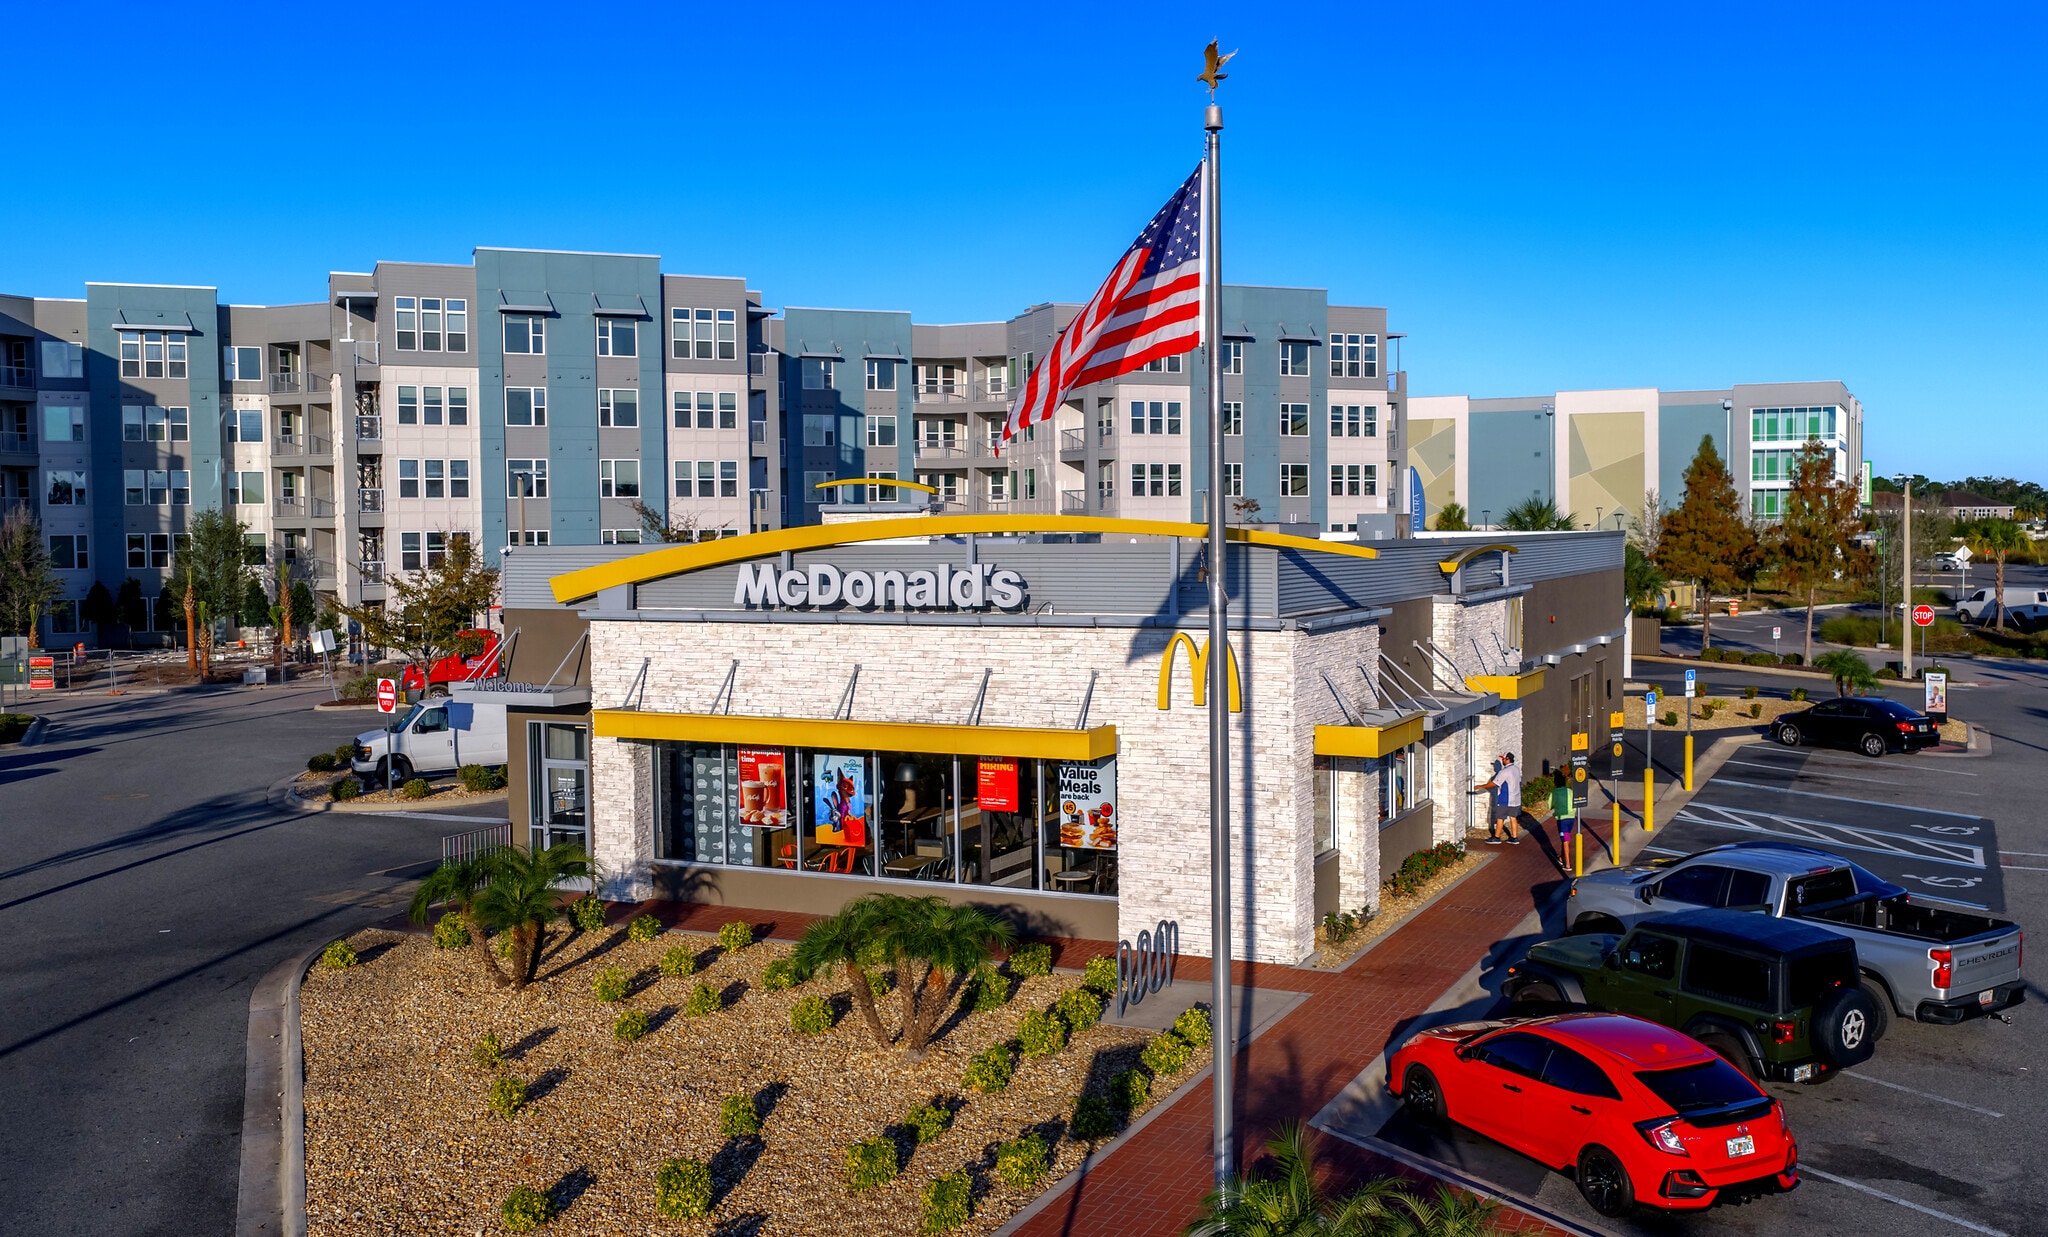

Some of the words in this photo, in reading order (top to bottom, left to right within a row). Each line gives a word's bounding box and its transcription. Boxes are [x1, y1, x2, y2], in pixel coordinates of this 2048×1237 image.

[733, 563, 1026, 608] McDonald's
[1914, 611, 1933, 620] STOP
[472, 677, 534, 693] Welcome
[980, 763, 1014, 771] HIRING
[1060, 766, 1098, 780] Value
[1060, 780, 1102, 794] Meals
[1959, 946, 2017, 967] CHEVROLET
